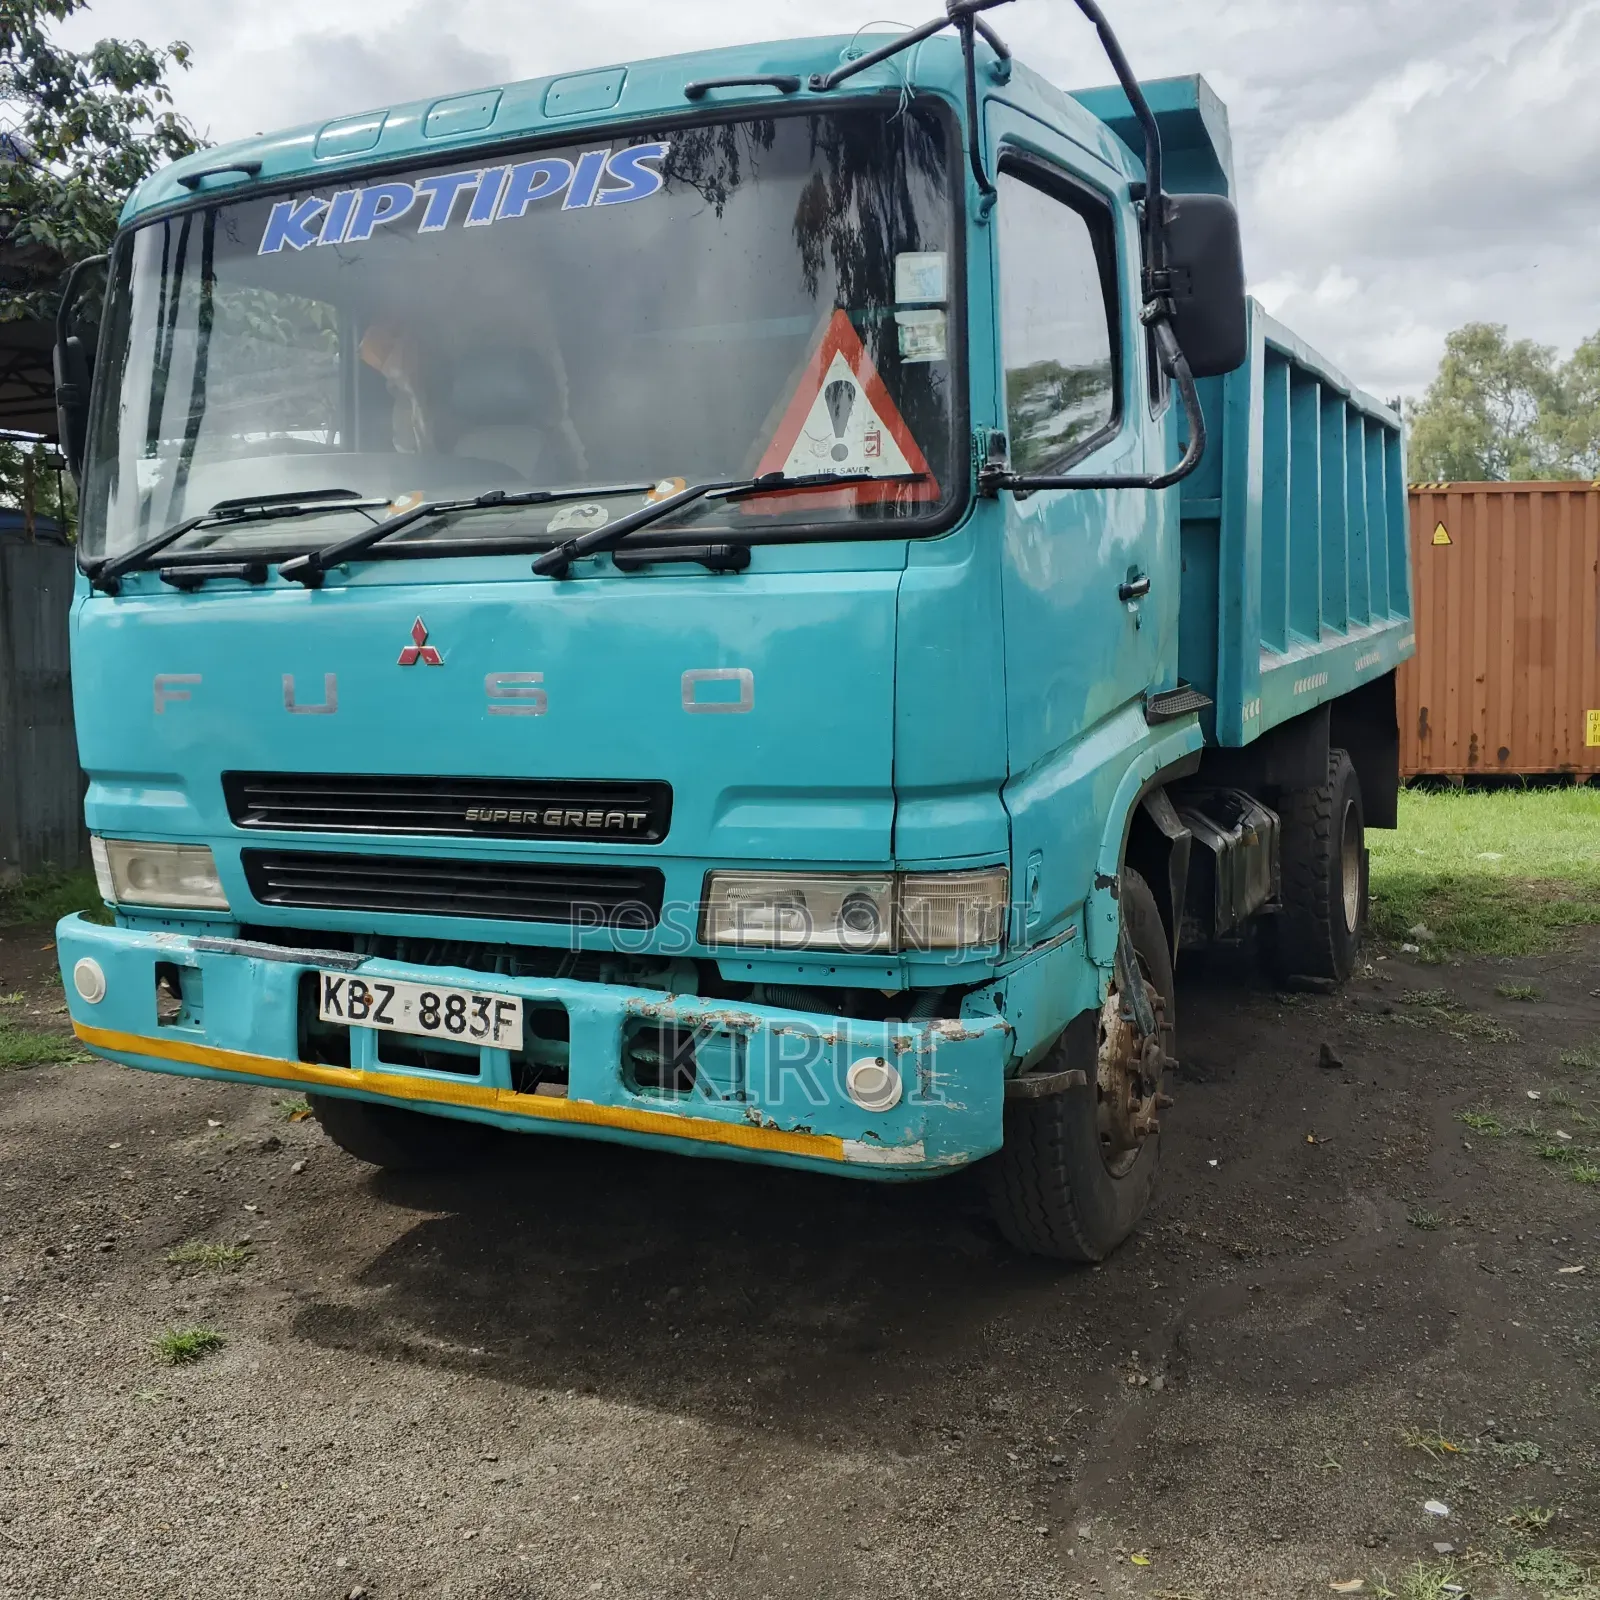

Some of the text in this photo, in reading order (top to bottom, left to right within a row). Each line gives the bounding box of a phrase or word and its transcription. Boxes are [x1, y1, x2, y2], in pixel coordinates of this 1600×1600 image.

[257, 141, 671, 256] KIPTIPIS
[840, 466, 871, 474] SAVER
[153, 667, 755, 716] FUSO
[465, 808, 647, 829] SUPER GREAT
[324, 976, 517, 1042] KBZ 883F
